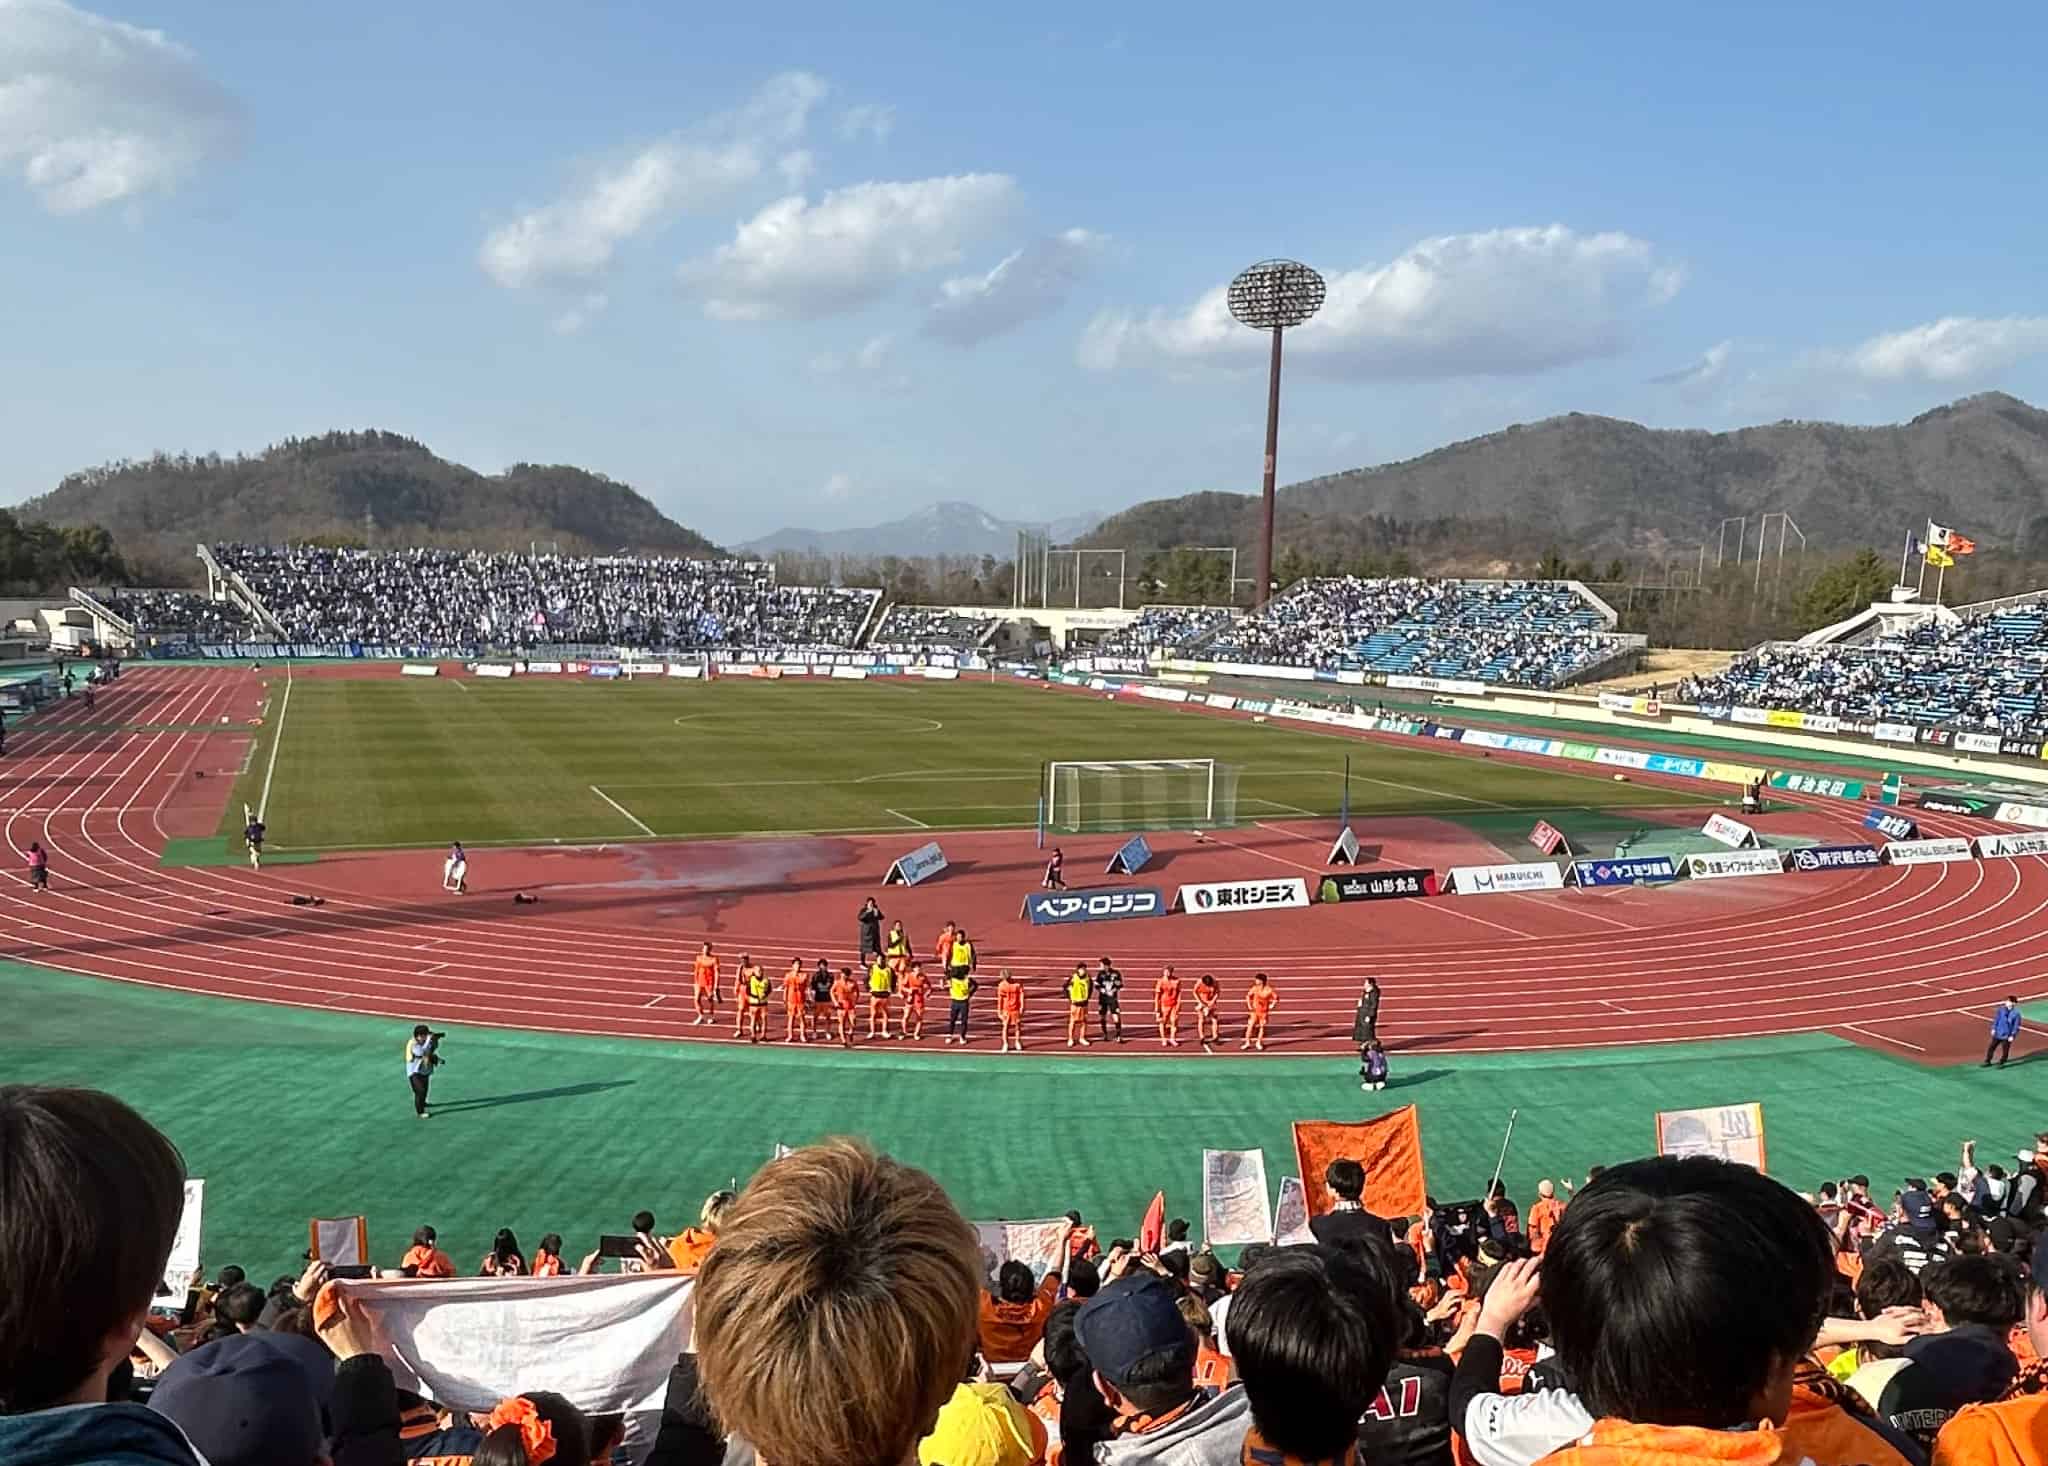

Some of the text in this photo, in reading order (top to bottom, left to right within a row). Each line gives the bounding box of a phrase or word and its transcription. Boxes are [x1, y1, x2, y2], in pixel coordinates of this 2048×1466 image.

[1370, 876, 1419, 894] 山形食品
[1495, 870, 1545, 882] MARUICHI
[1036, 891, 1156, 915] ベア・ロジコ
[1216, 884, 1296, 906] 東北シミズ
